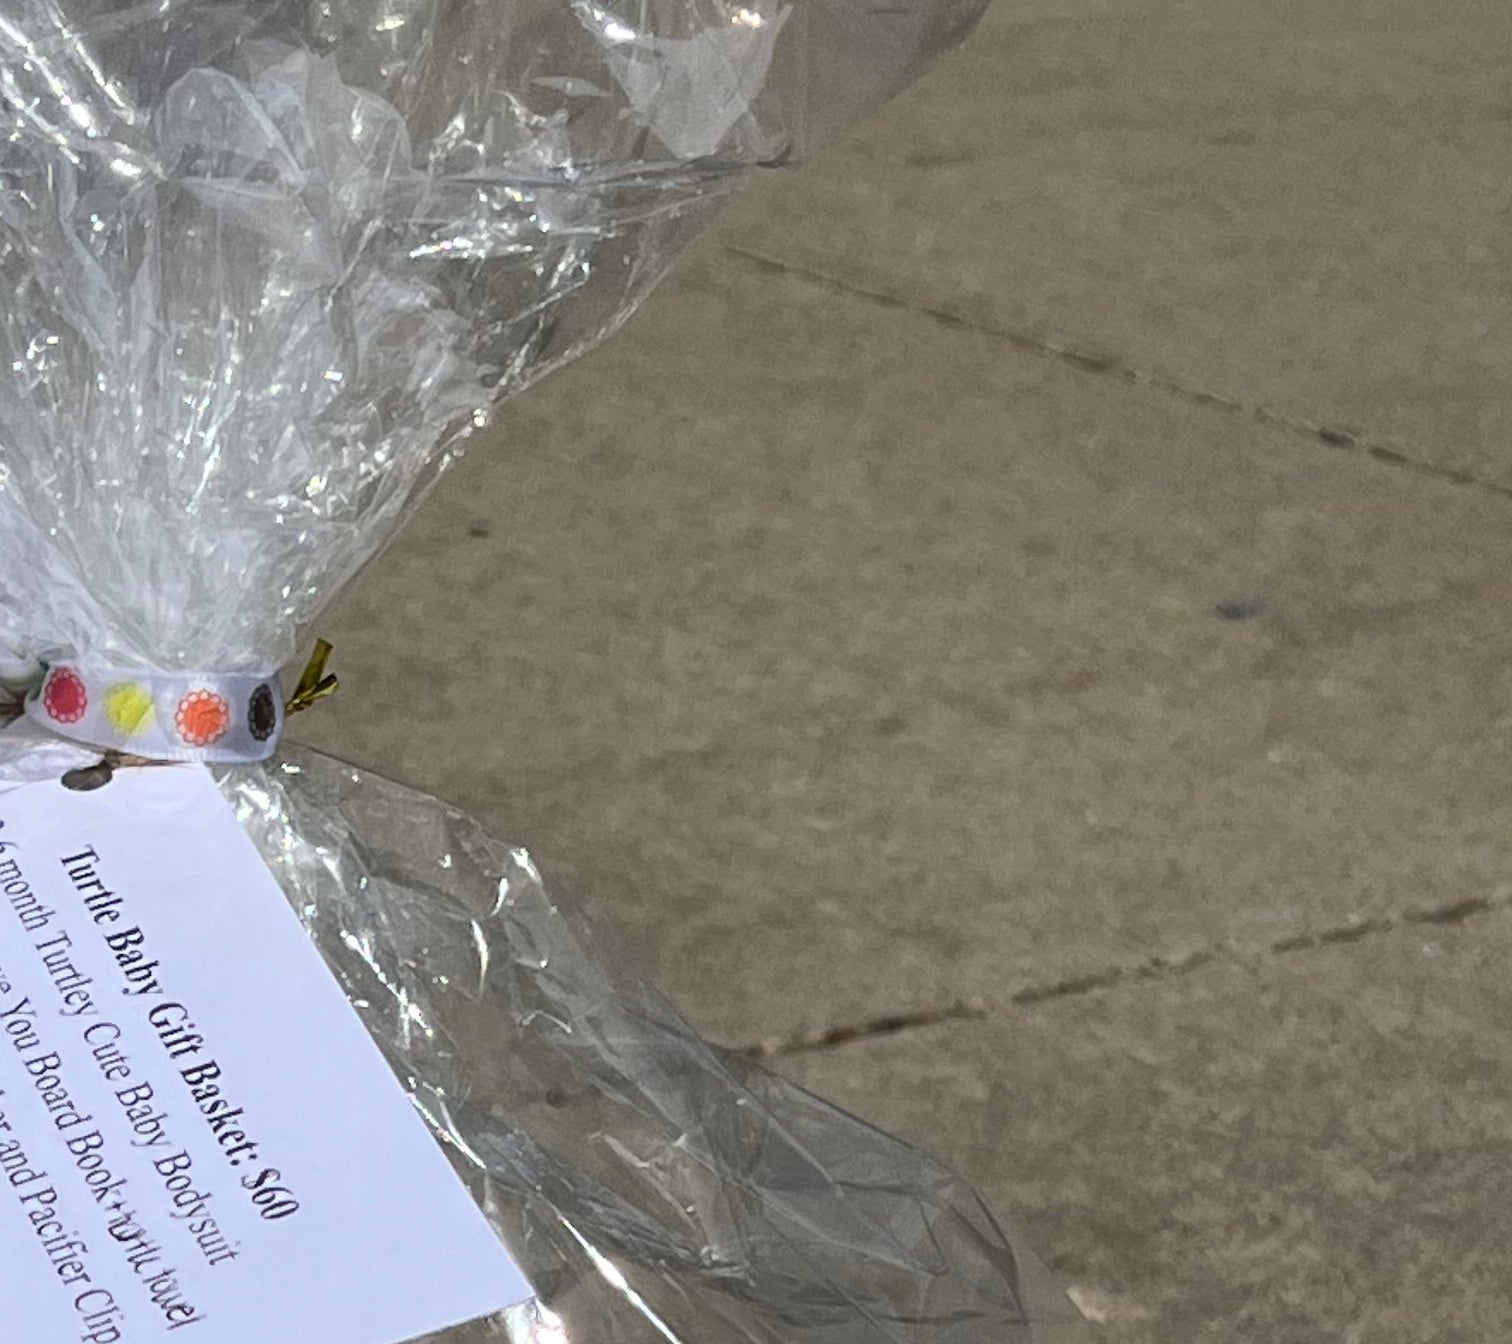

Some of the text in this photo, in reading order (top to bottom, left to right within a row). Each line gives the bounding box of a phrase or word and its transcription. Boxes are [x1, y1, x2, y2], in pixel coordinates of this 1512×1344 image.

[20, 1048, 94, 1132] Board
[33, 928, 99, 1017] Turtley
[82, 1020, 132, 1082] Cute
[112, 1078, 172, 1148] Baby
[150, 1147, 241, 1267] Bodysuit
[57, 842, 301, 1221] Turtle Baby Gift Basket: $60
[16, 1182, 92, 1287] Pacifier
[72, 1287, 125, 1344] Clip
